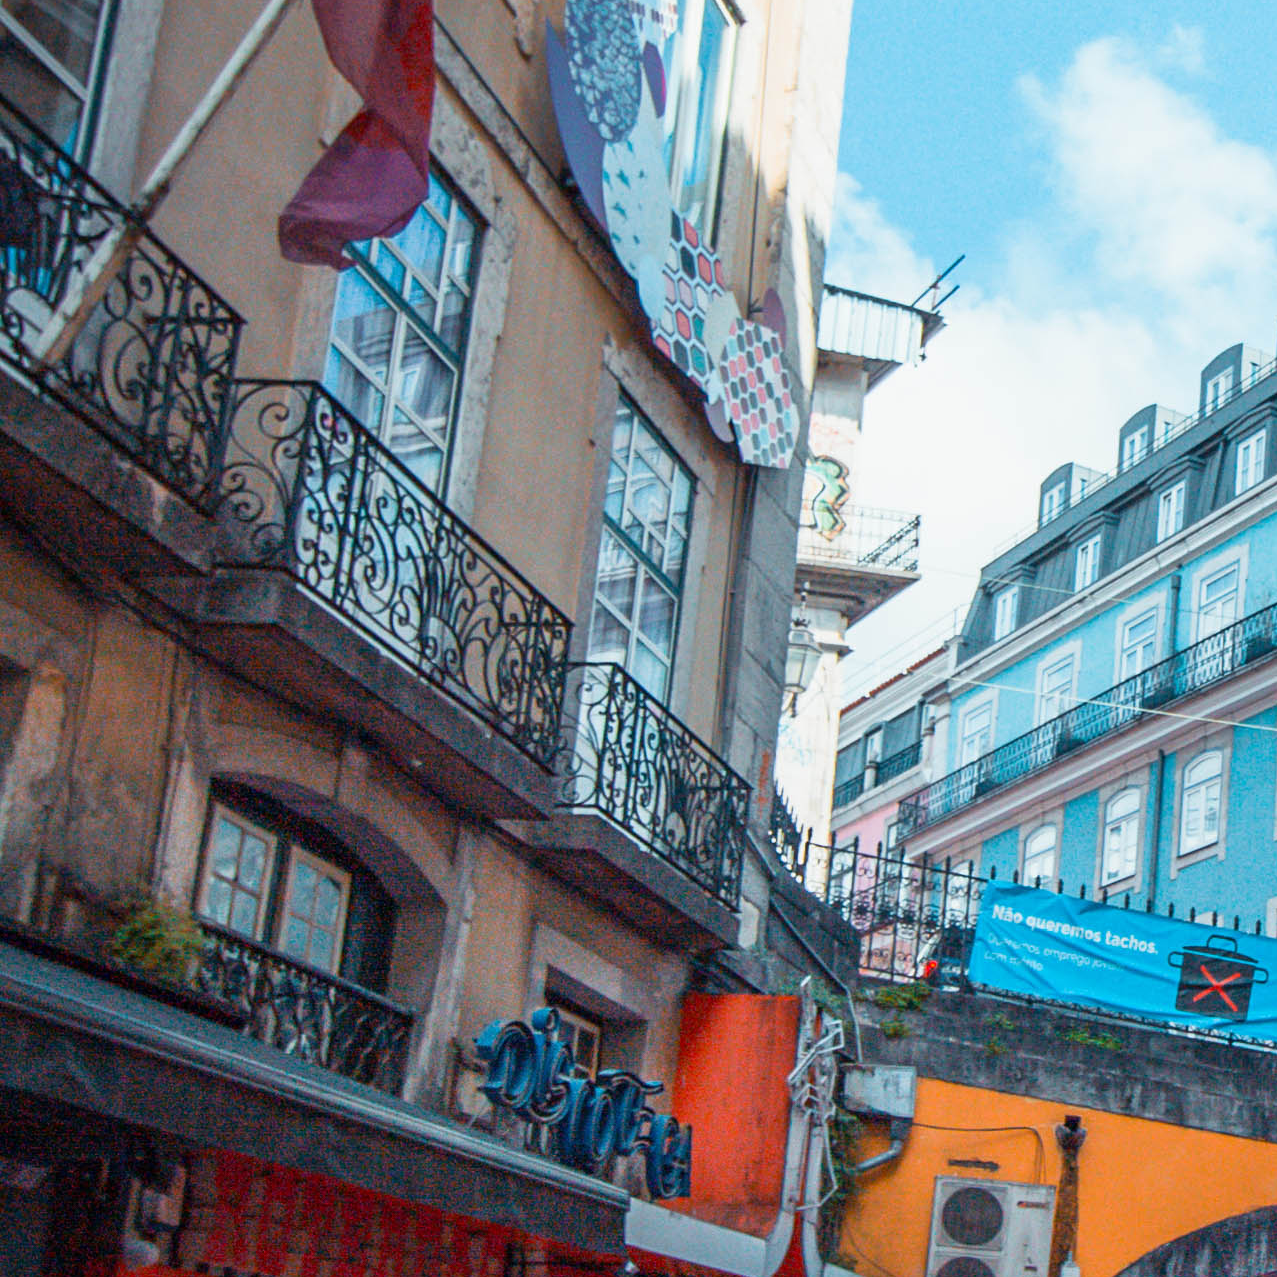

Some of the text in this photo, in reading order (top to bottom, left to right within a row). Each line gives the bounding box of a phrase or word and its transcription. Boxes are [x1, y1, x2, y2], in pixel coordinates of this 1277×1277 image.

[991, 904, 1159, 955] Não queremos tachos.
